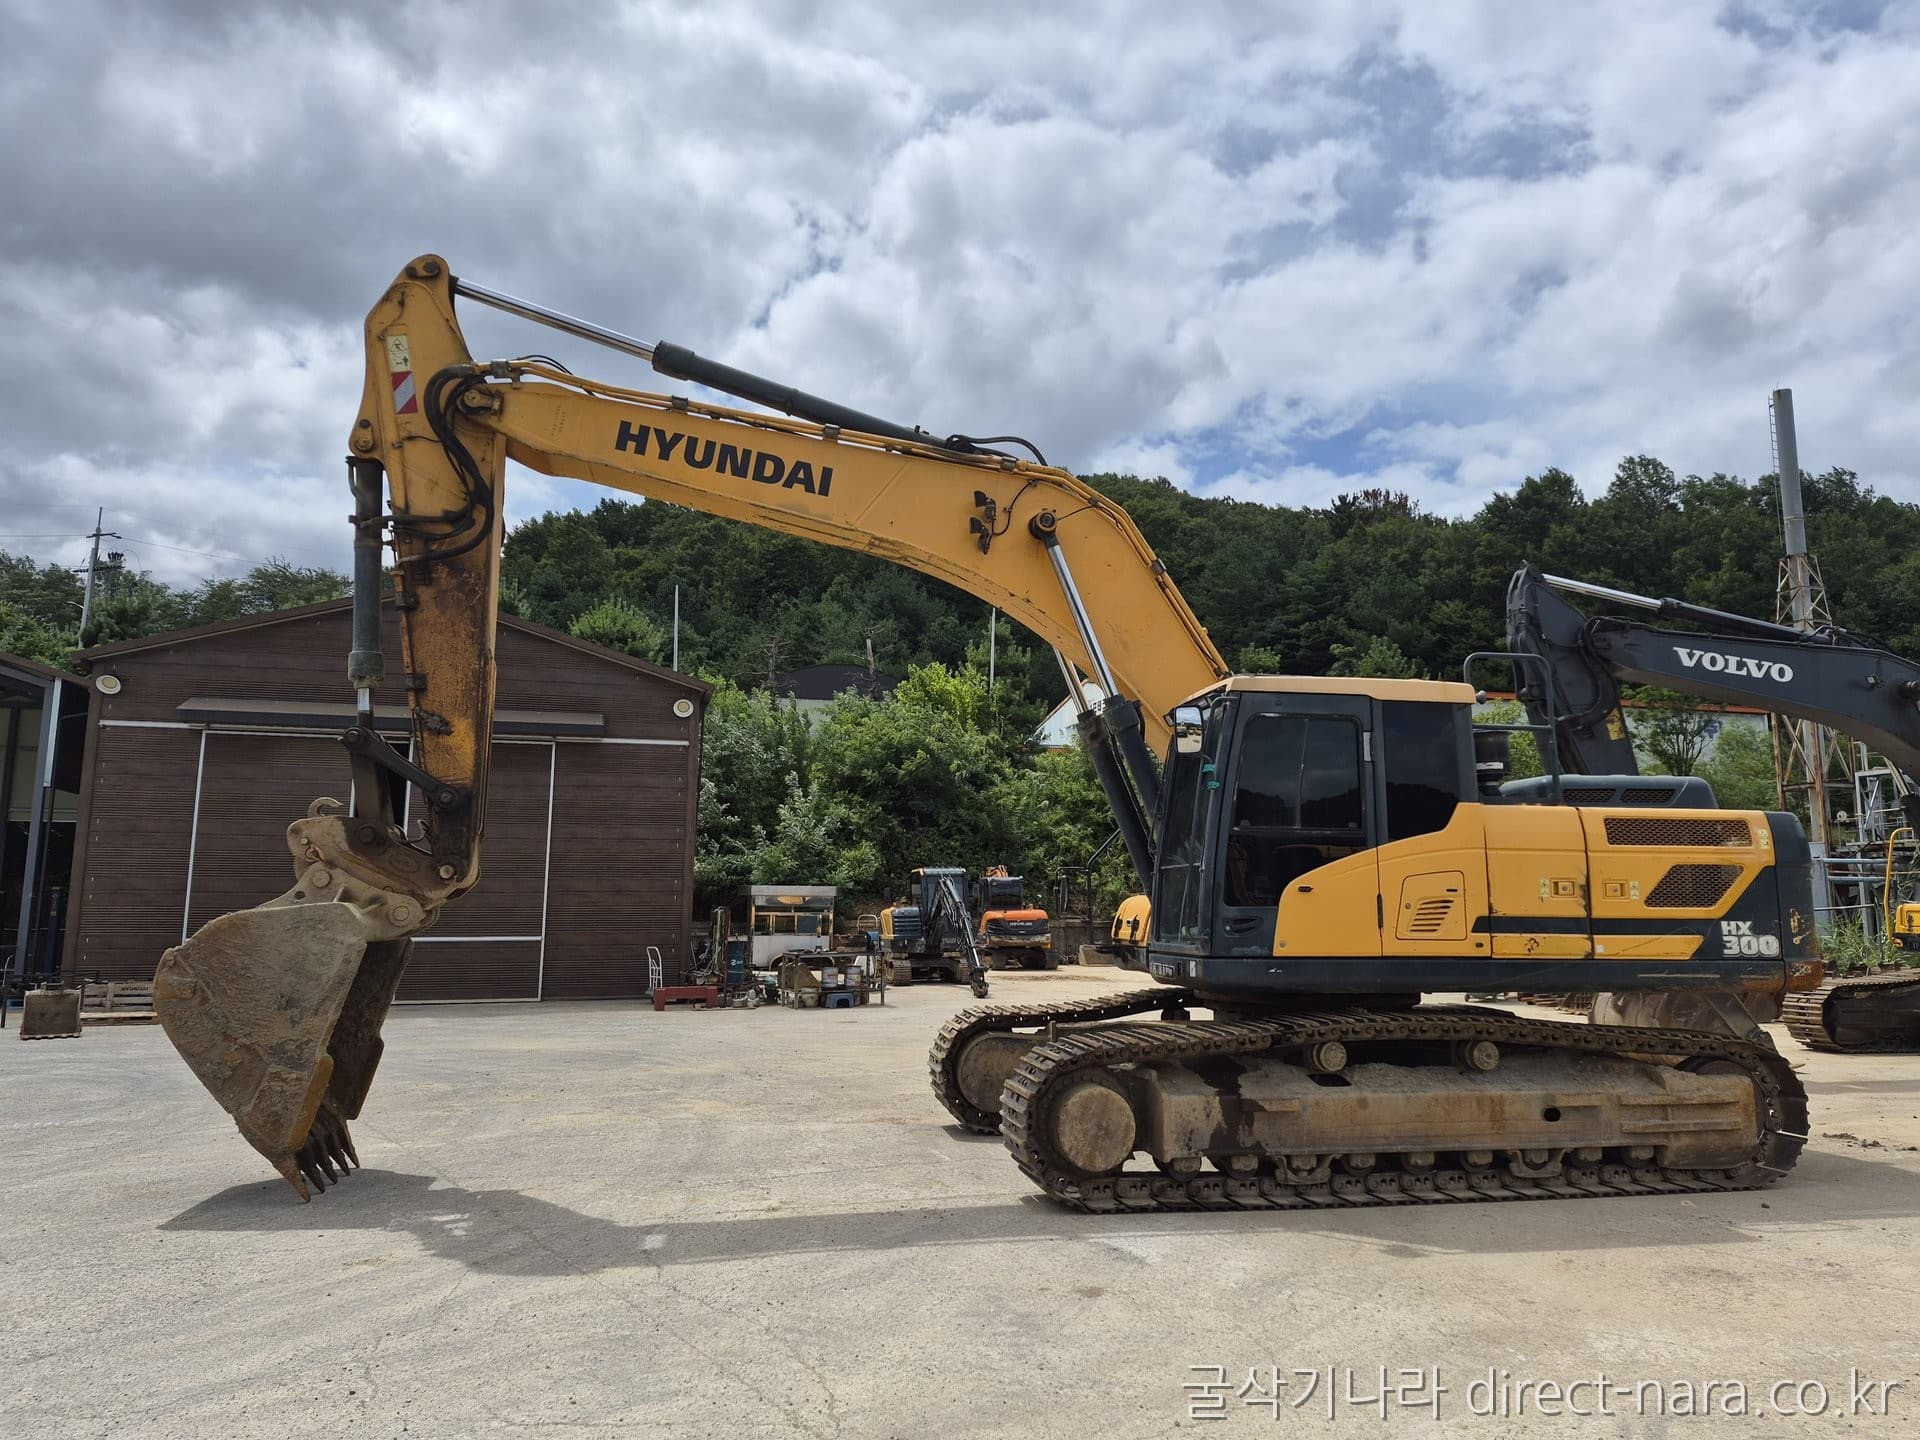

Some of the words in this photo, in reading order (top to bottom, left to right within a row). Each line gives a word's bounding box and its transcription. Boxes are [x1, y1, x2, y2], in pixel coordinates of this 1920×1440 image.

[615, 420, 834, 497] HYUNDAI
[1673, 647, 1794, 683] VOLVO
[1720, 920, 1753, 936] HX
[1722, 934, 1780, 958] 300
